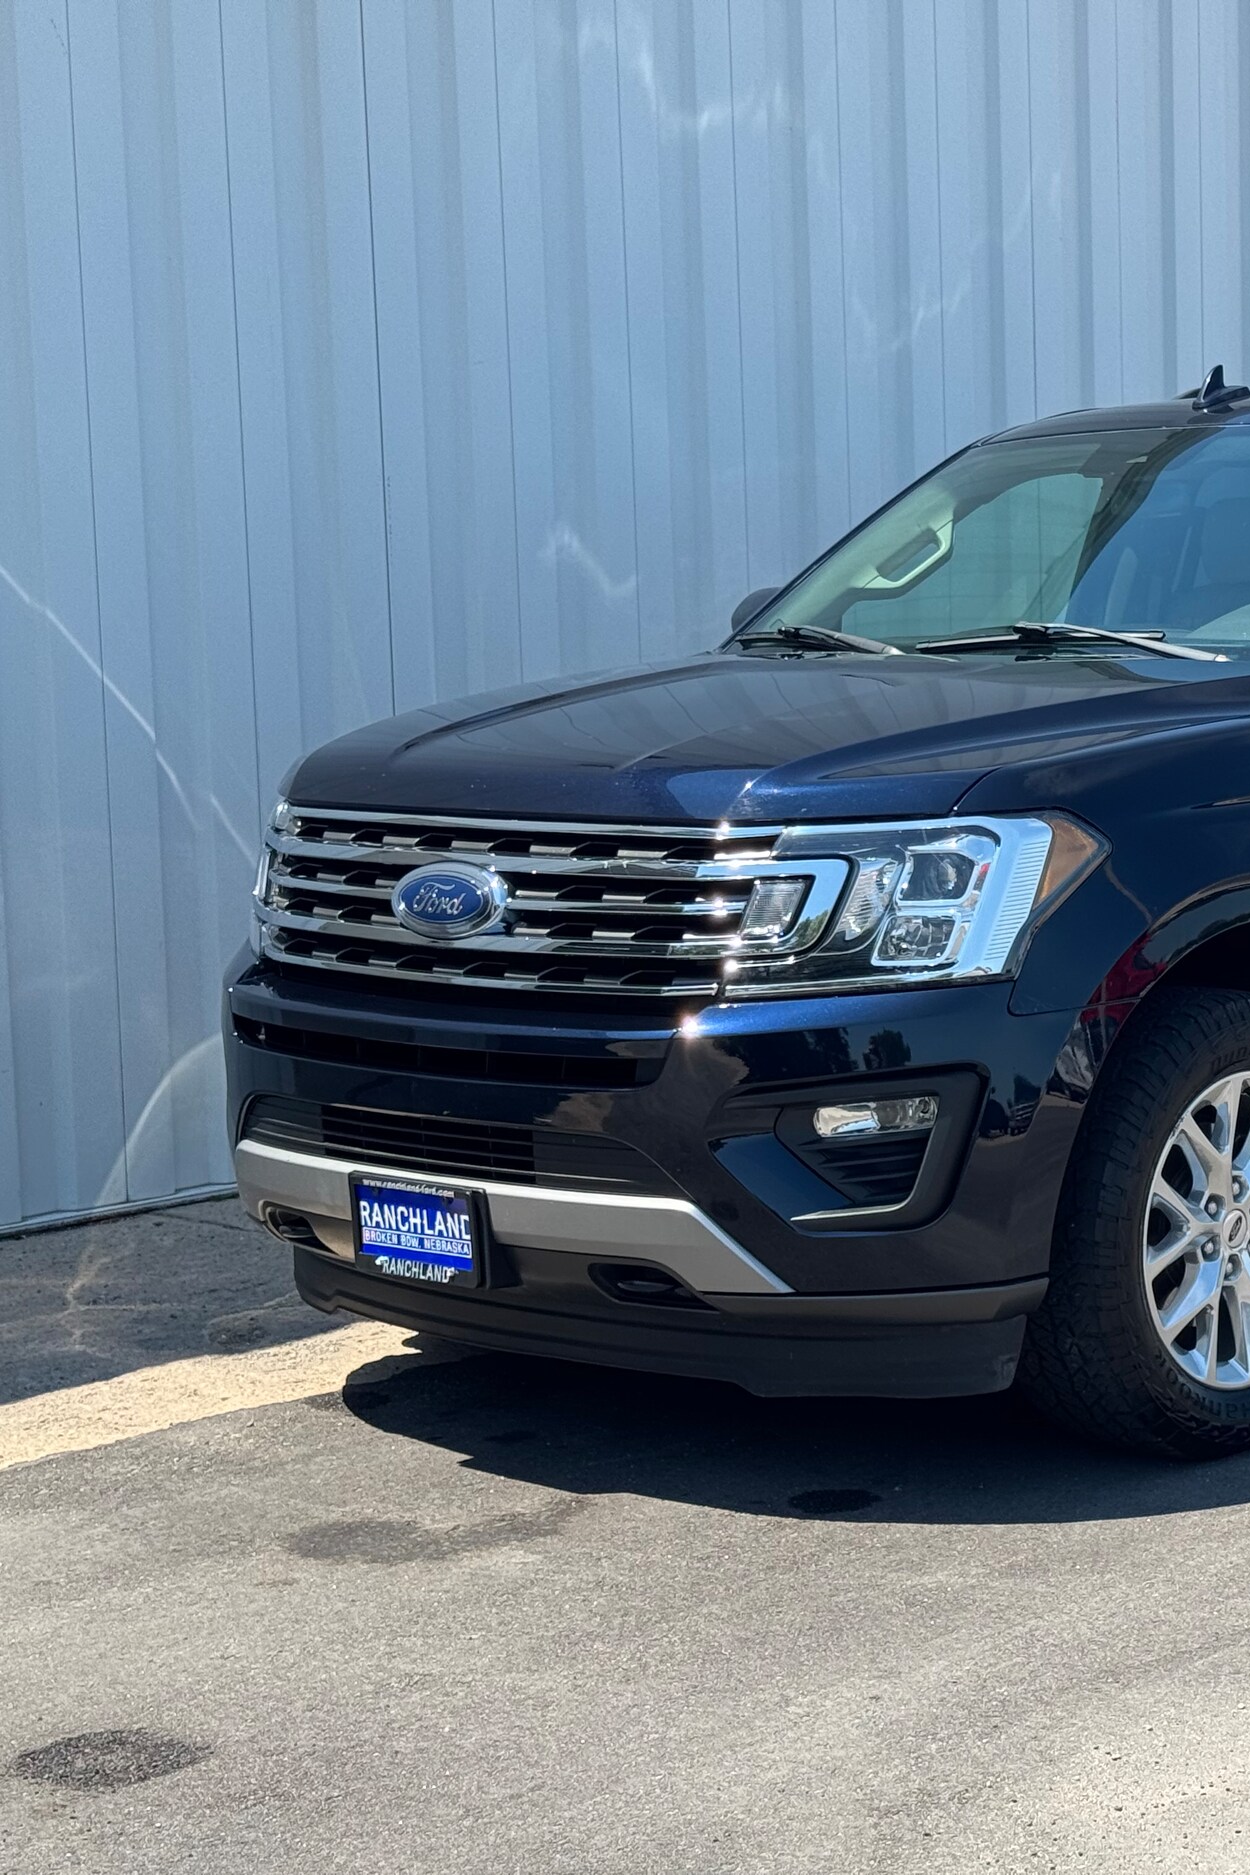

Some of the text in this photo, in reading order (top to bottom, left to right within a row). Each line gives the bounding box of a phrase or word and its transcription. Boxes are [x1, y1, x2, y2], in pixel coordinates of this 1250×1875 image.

[413, 881, 467, 916] Ford
[364, 1229, 398, 1245] BROKEN
[424, 1238, 470, 1255] NEBRASKA
[382, 1257, 453, 1284] RANCHLAND
